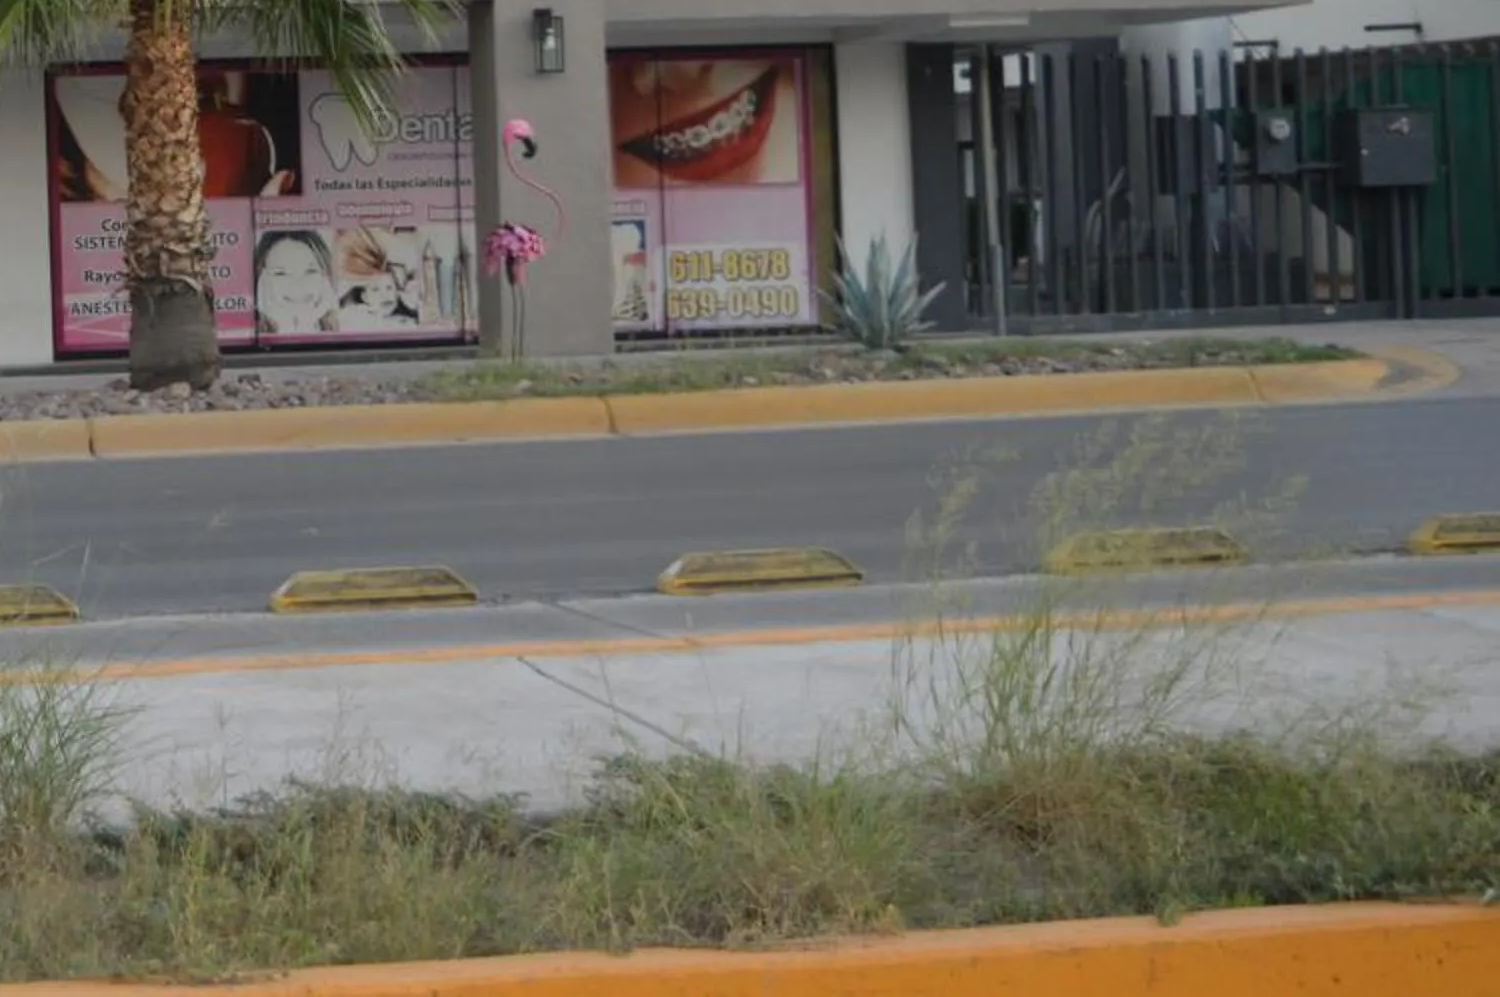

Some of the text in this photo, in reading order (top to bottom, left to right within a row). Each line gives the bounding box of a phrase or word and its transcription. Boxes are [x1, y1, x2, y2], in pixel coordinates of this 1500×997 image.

[314, 175, 473, 191] Todas las Especialidaes
